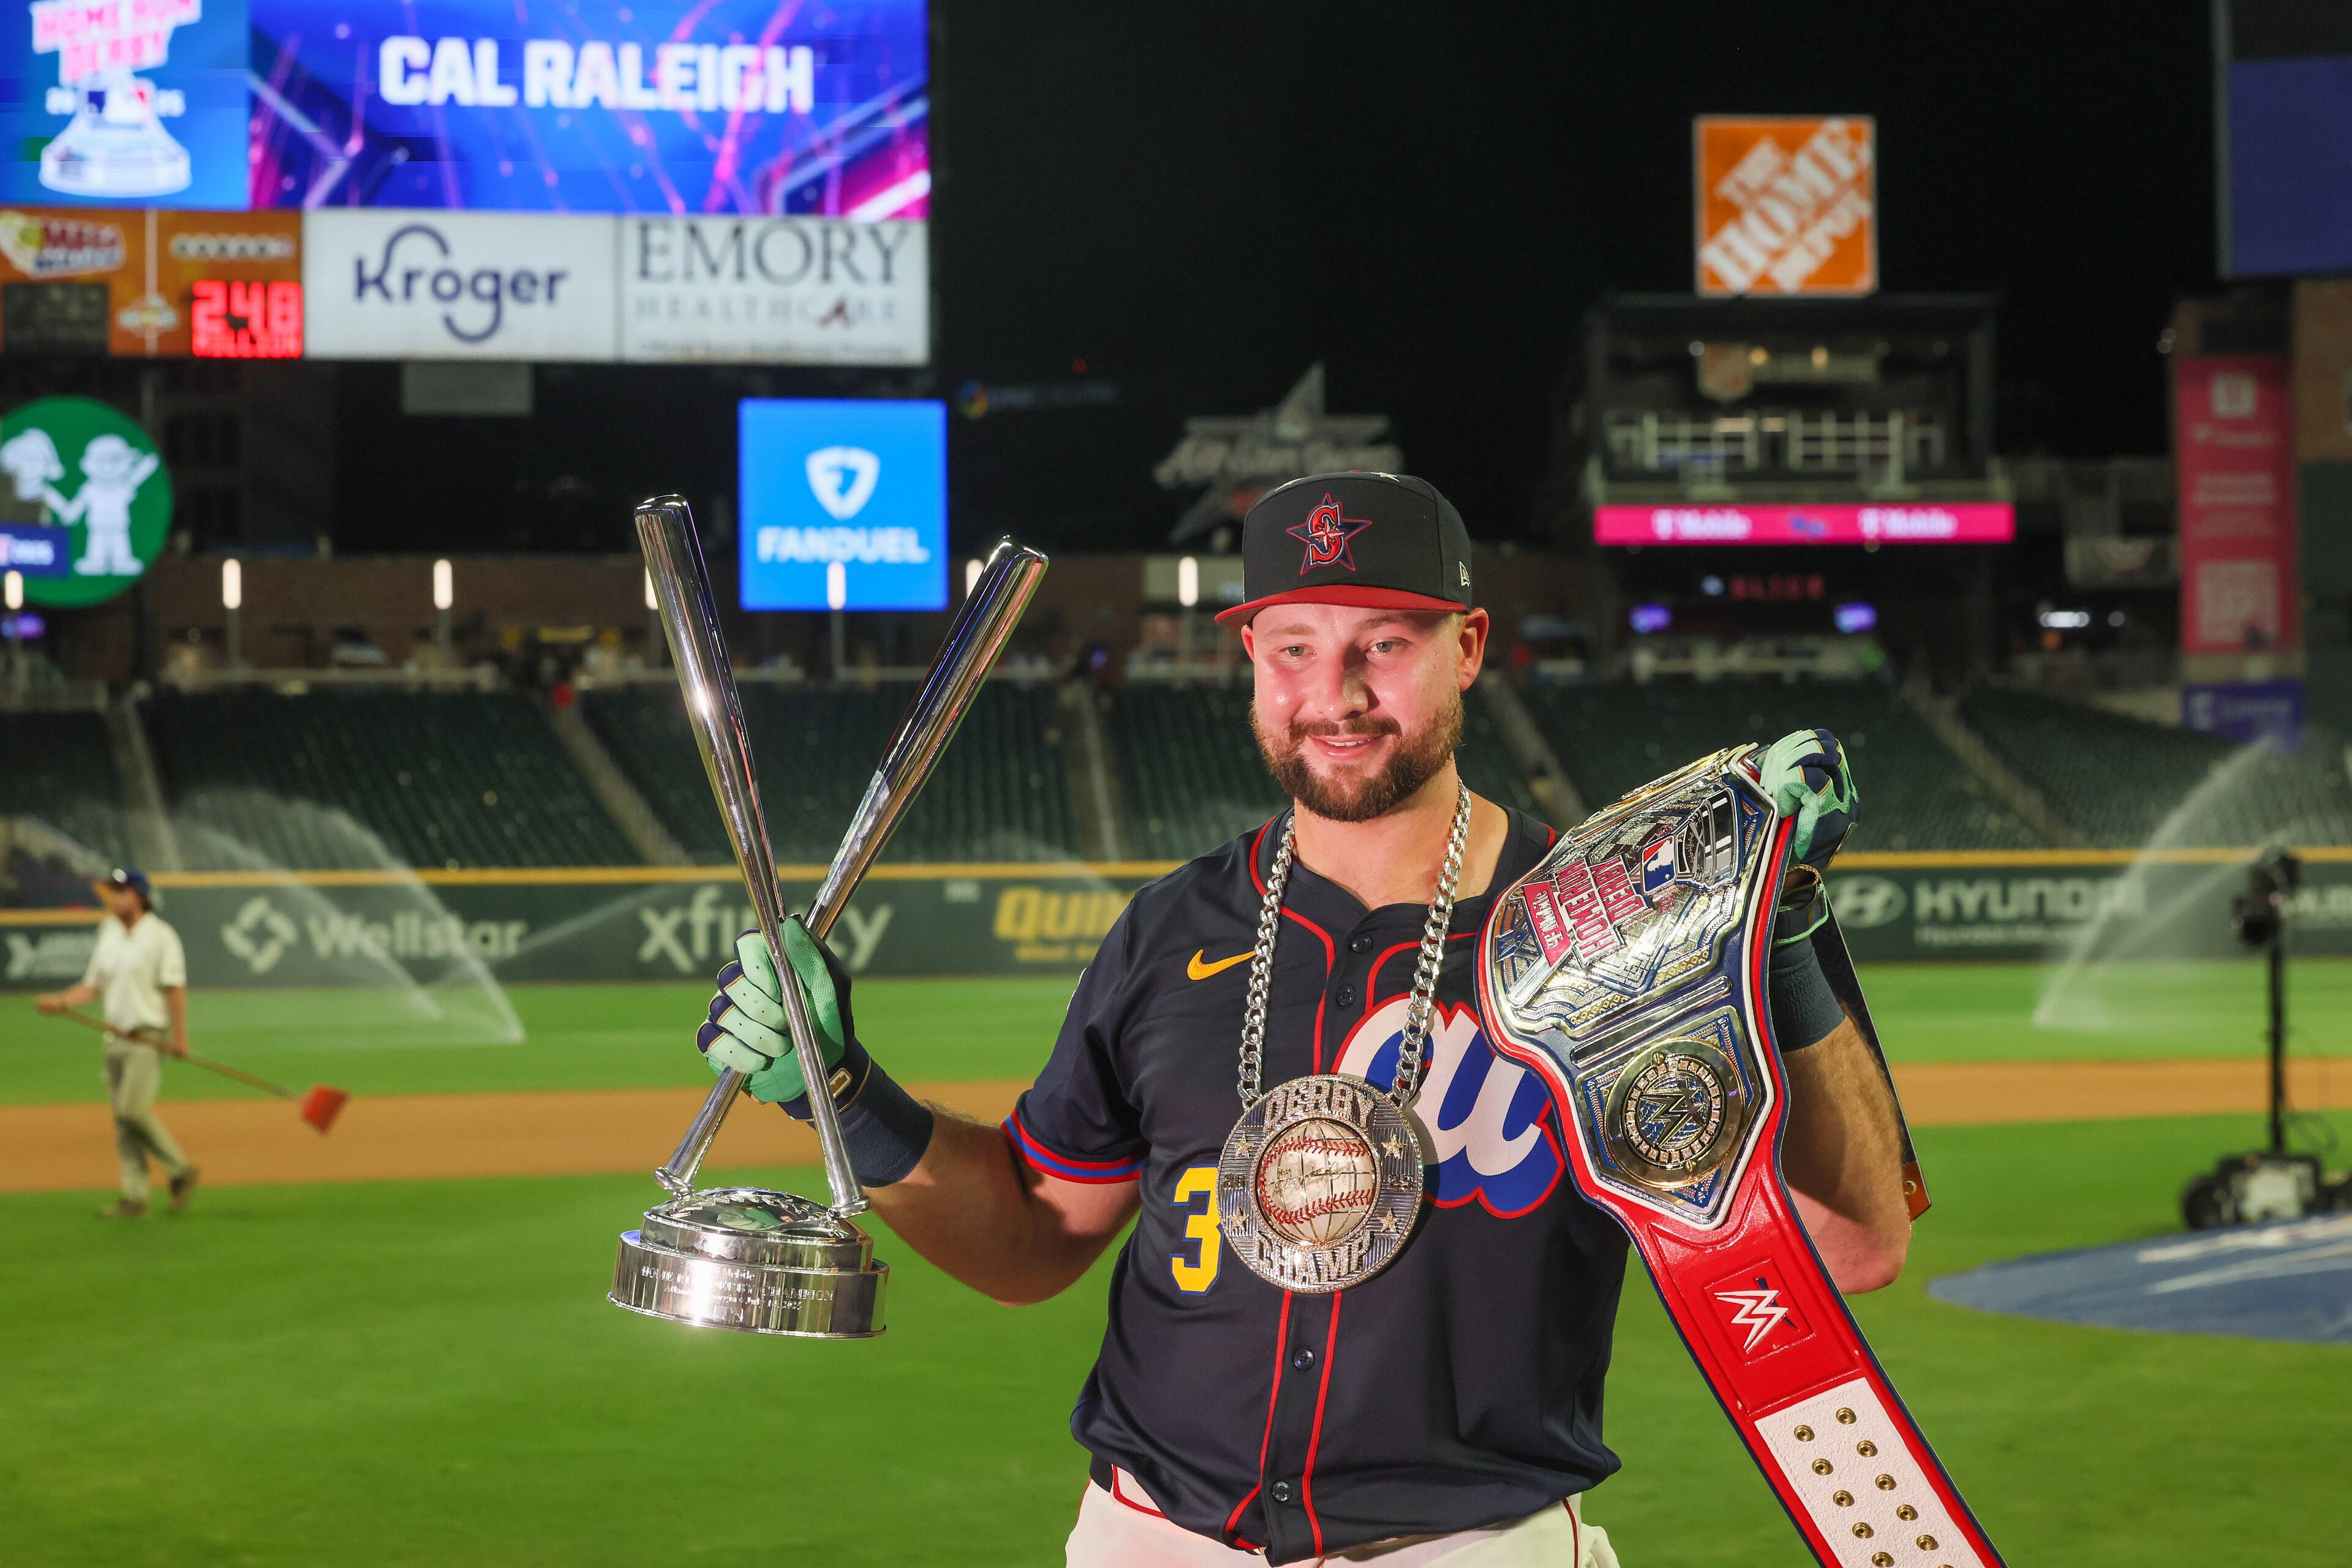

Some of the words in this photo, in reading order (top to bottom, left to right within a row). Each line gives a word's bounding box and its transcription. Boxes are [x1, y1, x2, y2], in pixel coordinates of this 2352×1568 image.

[380, 36, 518, 107] CAL
[524, 39, 814, 113] RALEIGH
[1699, 117, 1874, 292] HOME
[636, 219, 911, 289] EMORY
[192, 281, 303, 334] 248
[354, 224, 567, 343] Kroger
[757, 527, 930, 564] FANDUEL
[1556, 861, 1593, 903] RUN
[1593, 859, 1643, 922] DERBY
[1914, 878, 2148, 921] HYUNDAI
[306, 912, 526, 959] Wellstar
[1564, 892, 1619, 959] HOME
[1263, 1079, 1374, 1133] DERBY
[1254, 1230, 1372, 1286] CHAMP
[760, 1286, 834, 1302] CHAMPION
